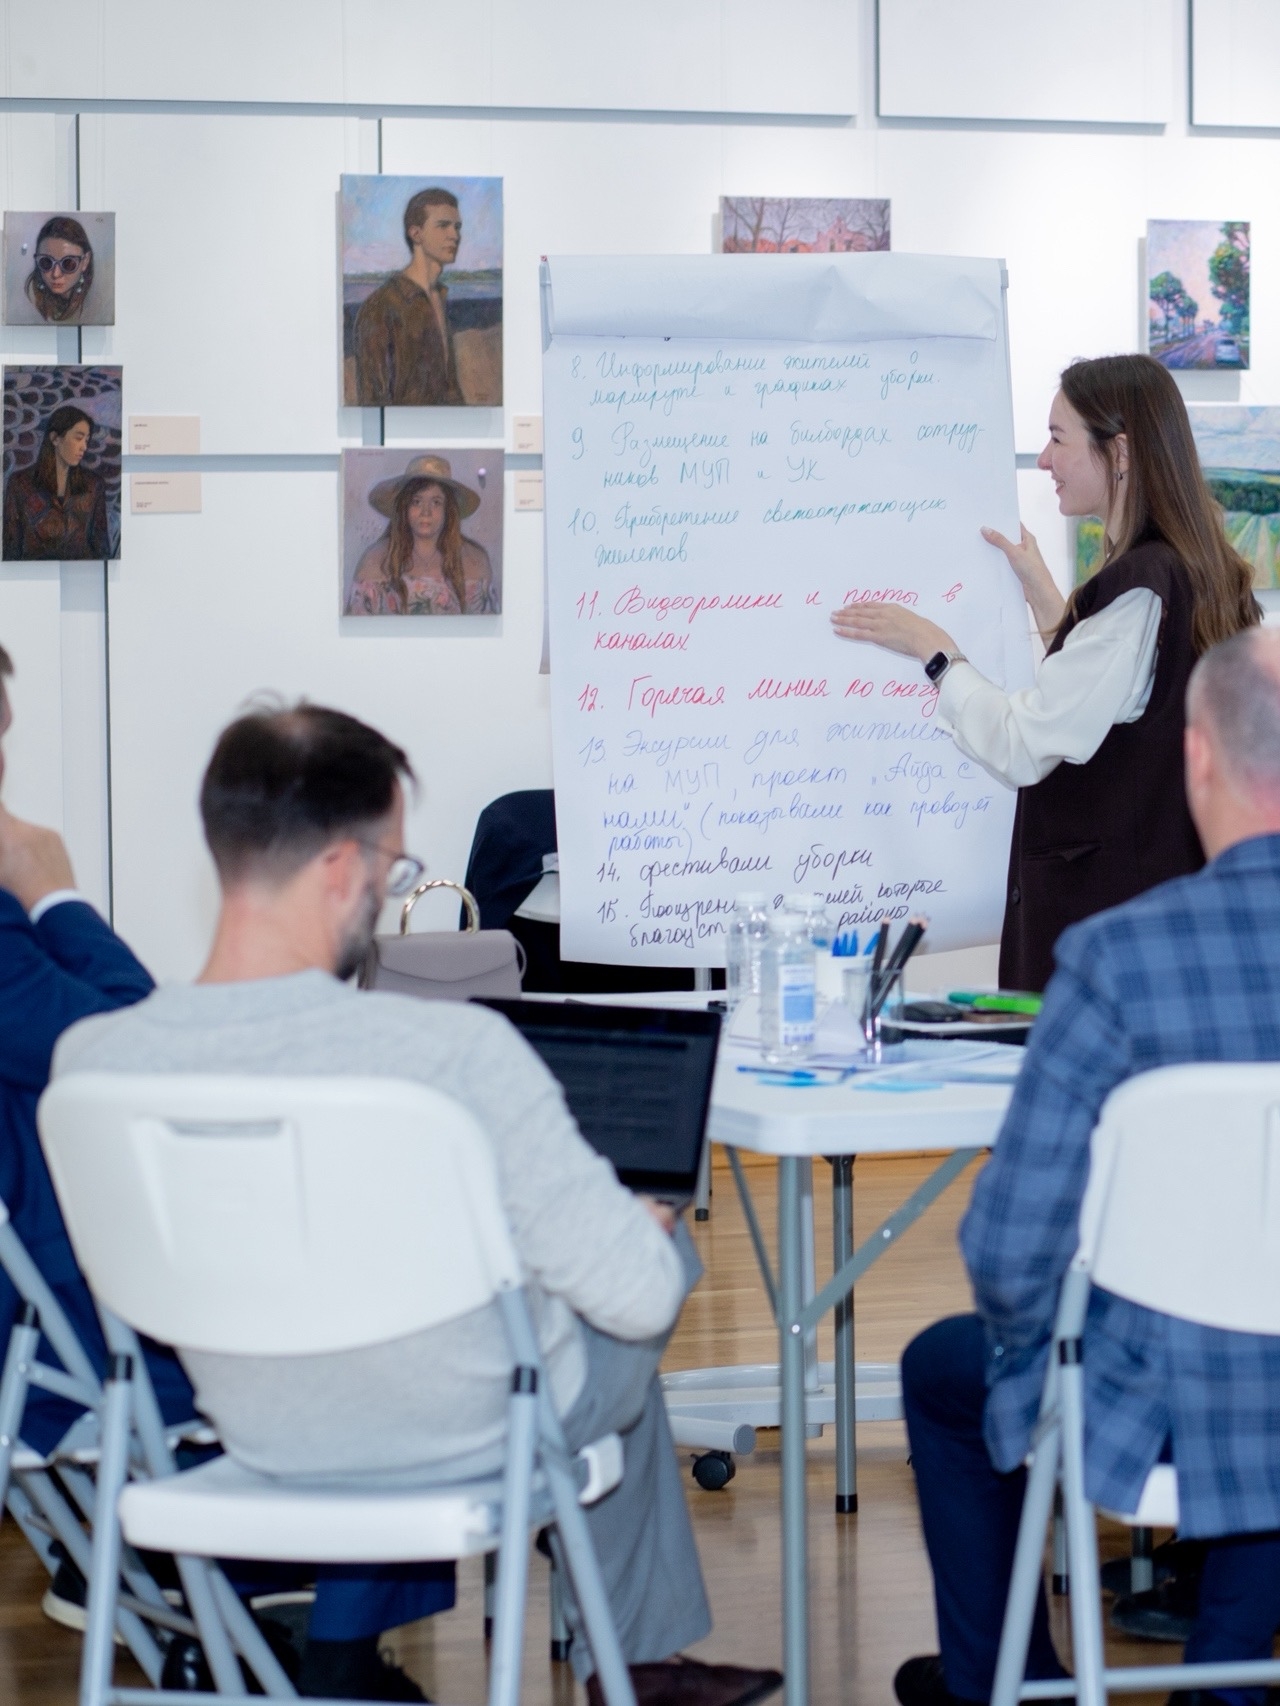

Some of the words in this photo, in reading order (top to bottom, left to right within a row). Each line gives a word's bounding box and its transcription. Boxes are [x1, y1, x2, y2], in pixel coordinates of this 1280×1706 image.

[571, 355, 586, 380] 8.
[784, 353, 870, 370] жителей
[724, 386, 736, 396] и
[754, 378, 847, 408] графиках
[571, 427, 588, 460] 9.
[611, 422, 730, 468] Размещение
[751, 430, 768, 447] на
[790, 420, 892, 458] билбордах
[917, 422, 986, 453] сотруд-
[604, 464, 659, 488] ников
[680, 458, 730, 489] МУП
[757, 470, 770, 479] и
[786, 455, 824, 482] УК
[568, 508, 599, 536] 10.
[762, 498, 947, 525] светоотражающих
[595, 531, 688, 568] жилетов
[576, 590, 602, 620] 11.
[614, 584, 783, 624] Видеоролики
[806, 591, 822, 605] и
[843, 588, 919, 606] посты
[941, 582, 963, 603] в
[594, 631, 690, 651] каналах
[578, 683, 604, 712] 12.
[627, 675, 725, 719] Горячая
[748, 678, 831, 699] линия
[844, 678, 874, 698] по
[881, 679, 941, 718] снегу
[743, 728, 800, 765] для
[608, 772, 638, 795] на
[752, 767, 847, 798] проект
[864, 801, 893, 817] как
[910, 791, 993, 829] проводят
[597, 863, 621, 883] 14.
[794, 844, 873, 884] уборки
[597, 898, 629, 924] 15.
[640, 890, 738, 929] Поощрени
[629, 921, 727, 949] благоуст
